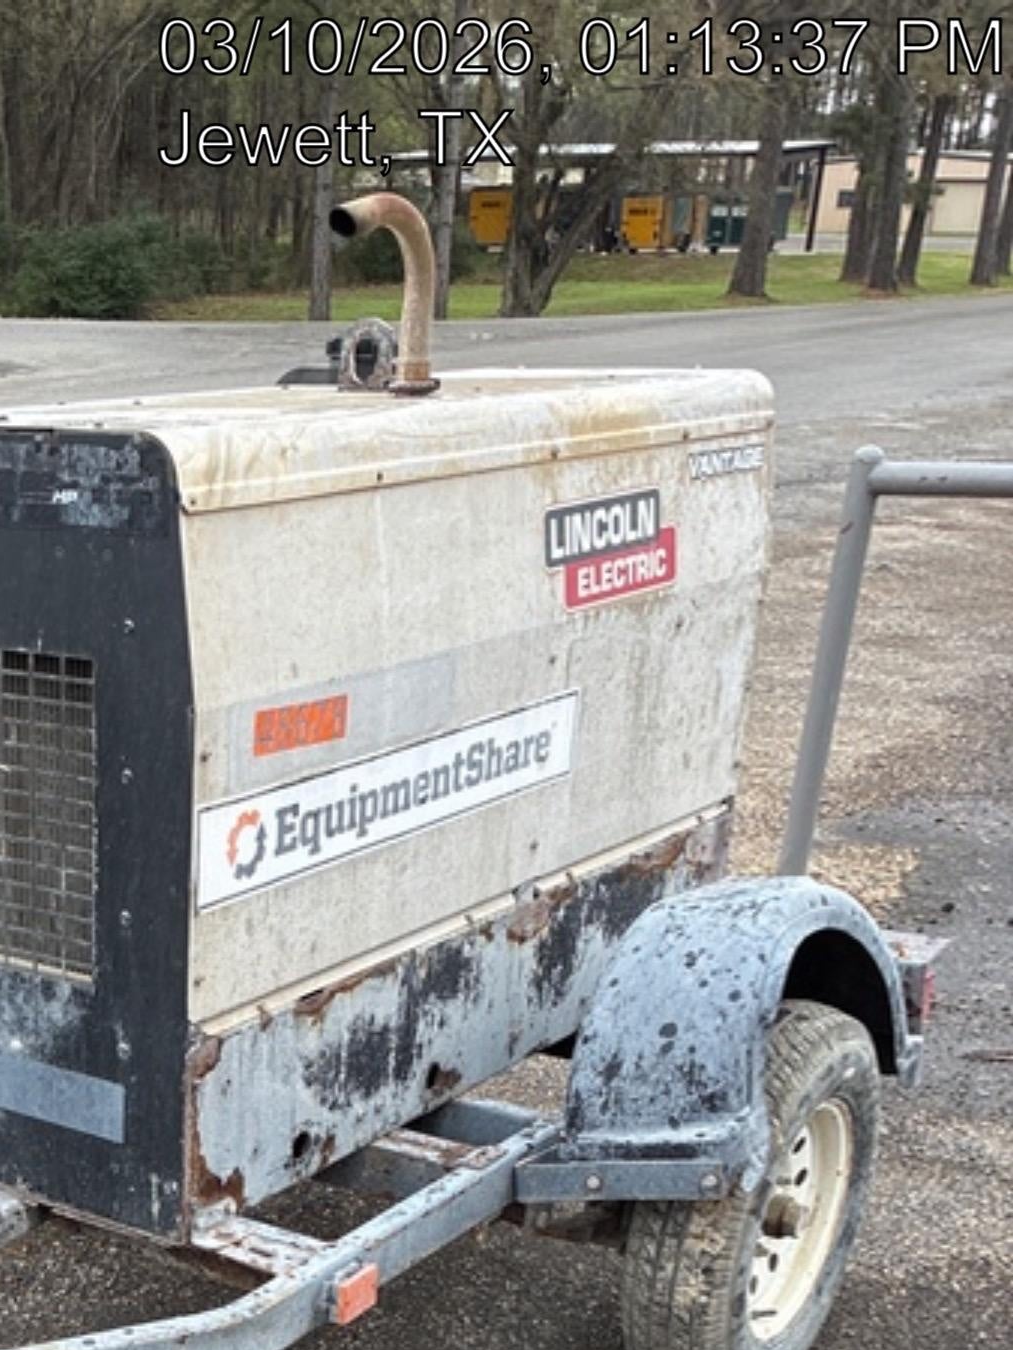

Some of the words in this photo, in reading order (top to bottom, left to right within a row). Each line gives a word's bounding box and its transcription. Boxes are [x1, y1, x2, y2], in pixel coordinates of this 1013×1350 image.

[549, 497, 656, 560] LINCOLN
[577, 548, 668, 598] ELECTRIC
[274, 730, 552, 856] EquipmentShare
